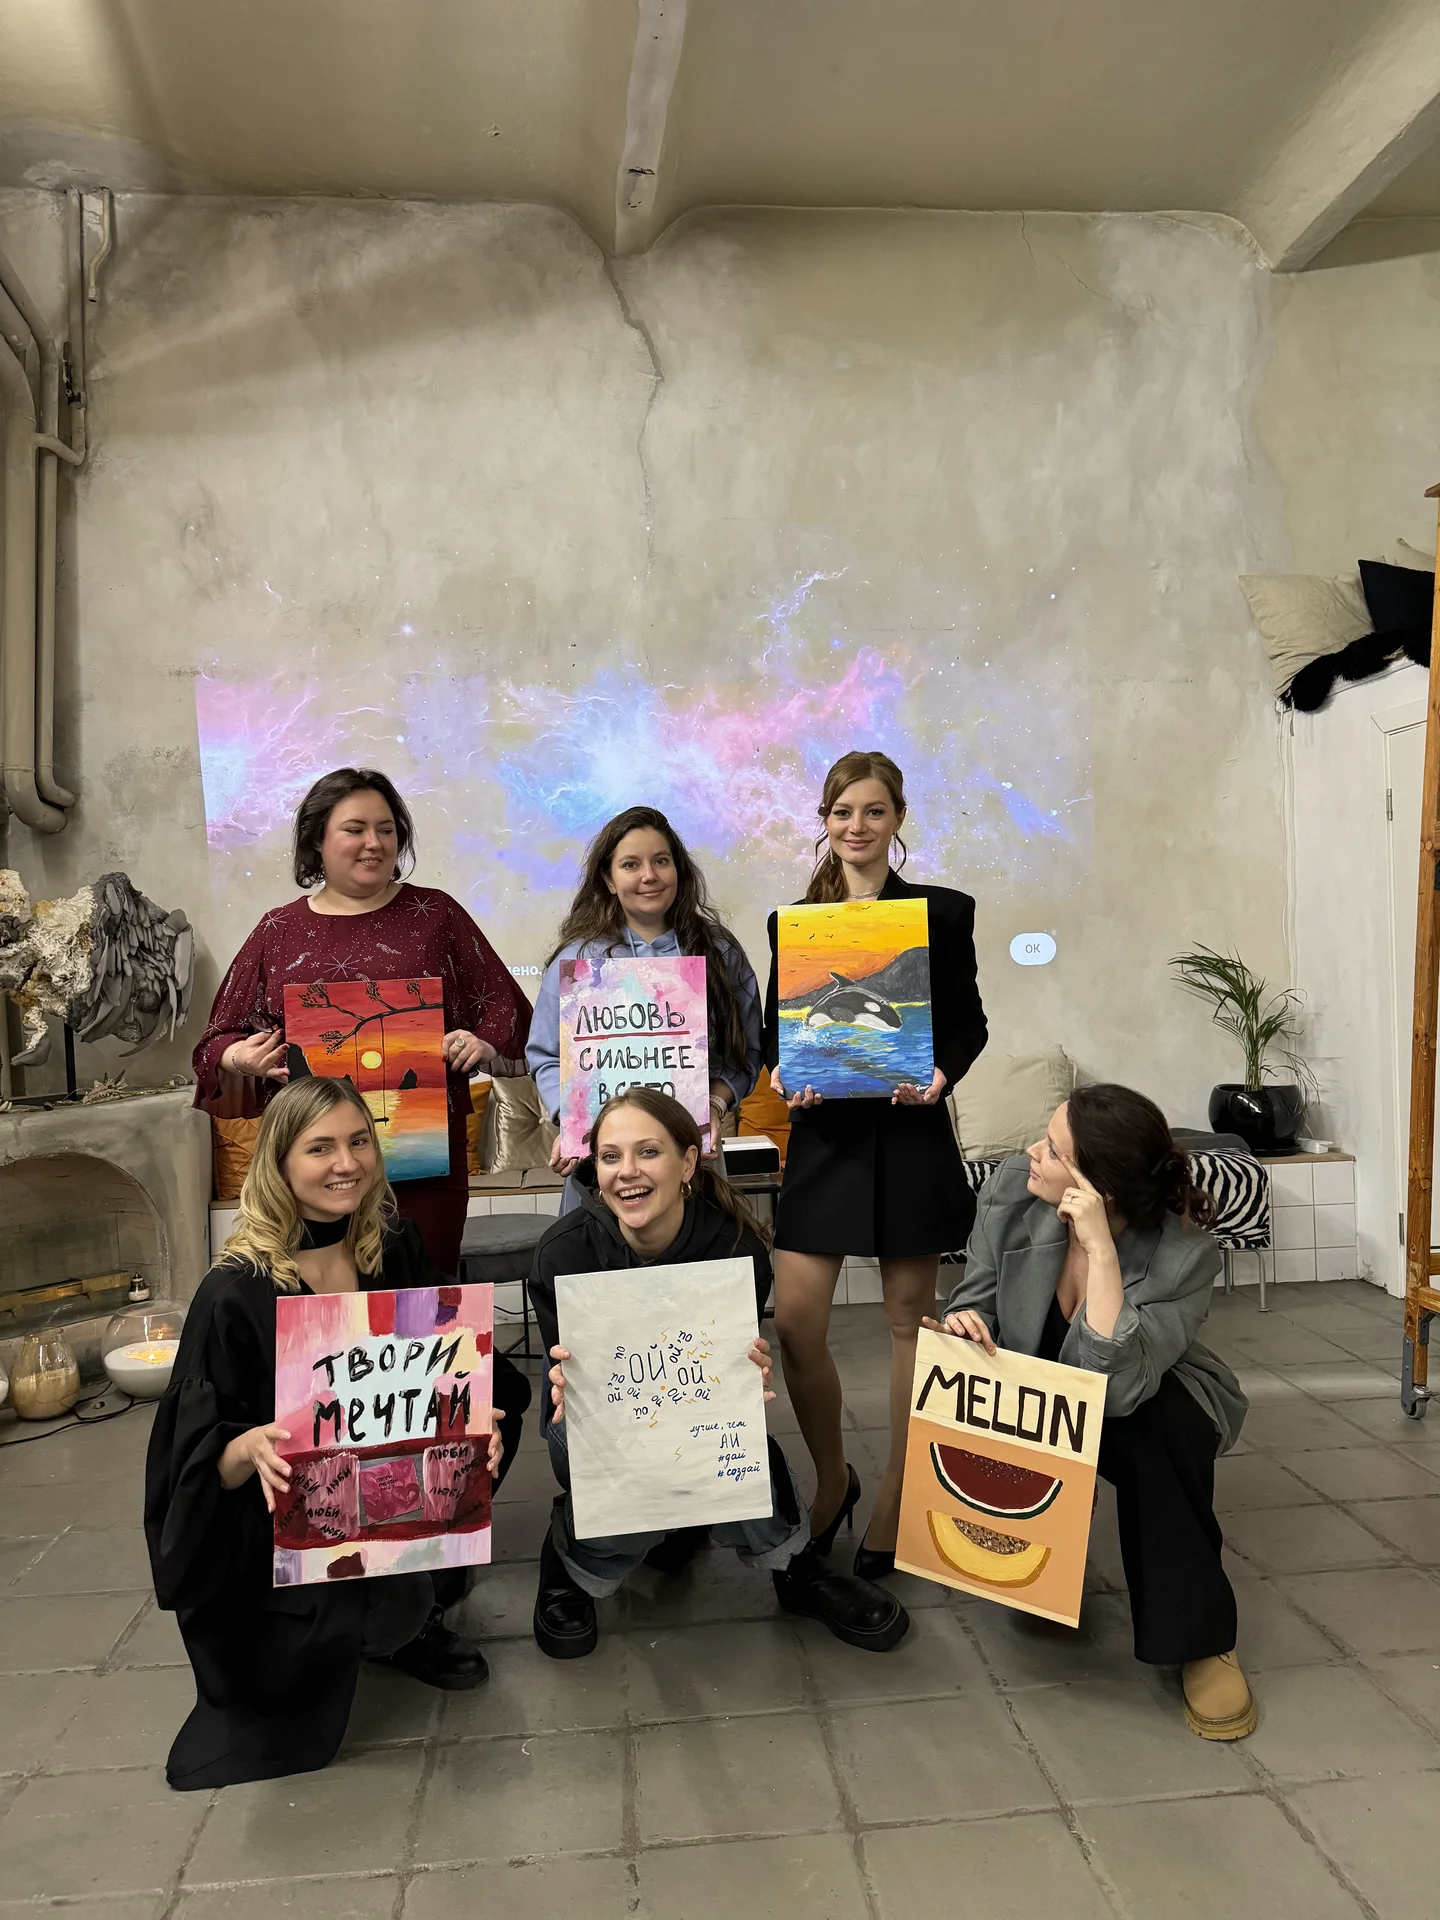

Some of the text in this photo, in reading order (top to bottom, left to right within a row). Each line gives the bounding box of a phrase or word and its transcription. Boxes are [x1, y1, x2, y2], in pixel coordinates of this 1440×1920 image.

[1025, 943, 1041, 954] OK
[576, 1001, 686, 1035] ЛЮБОВЬ
[579, 1045, 695, 1071] СИЛЬНЕЕ
[598, 1081, 676, 1105] ВСО
[312, 1334, 465, 1387] ТВОРИ
[915, 1365, 1087, 1454] MELON
[429, 1445, 469, 1463] ЛЮБИ
[717, 1448, 746, 1470] #дай
[291, 1471, 321, 1495] ЮБИ
[305, 1505, 341, 1519] ЛЮБИ
[319, 1523, 347, 1541] ЛЮБИ
